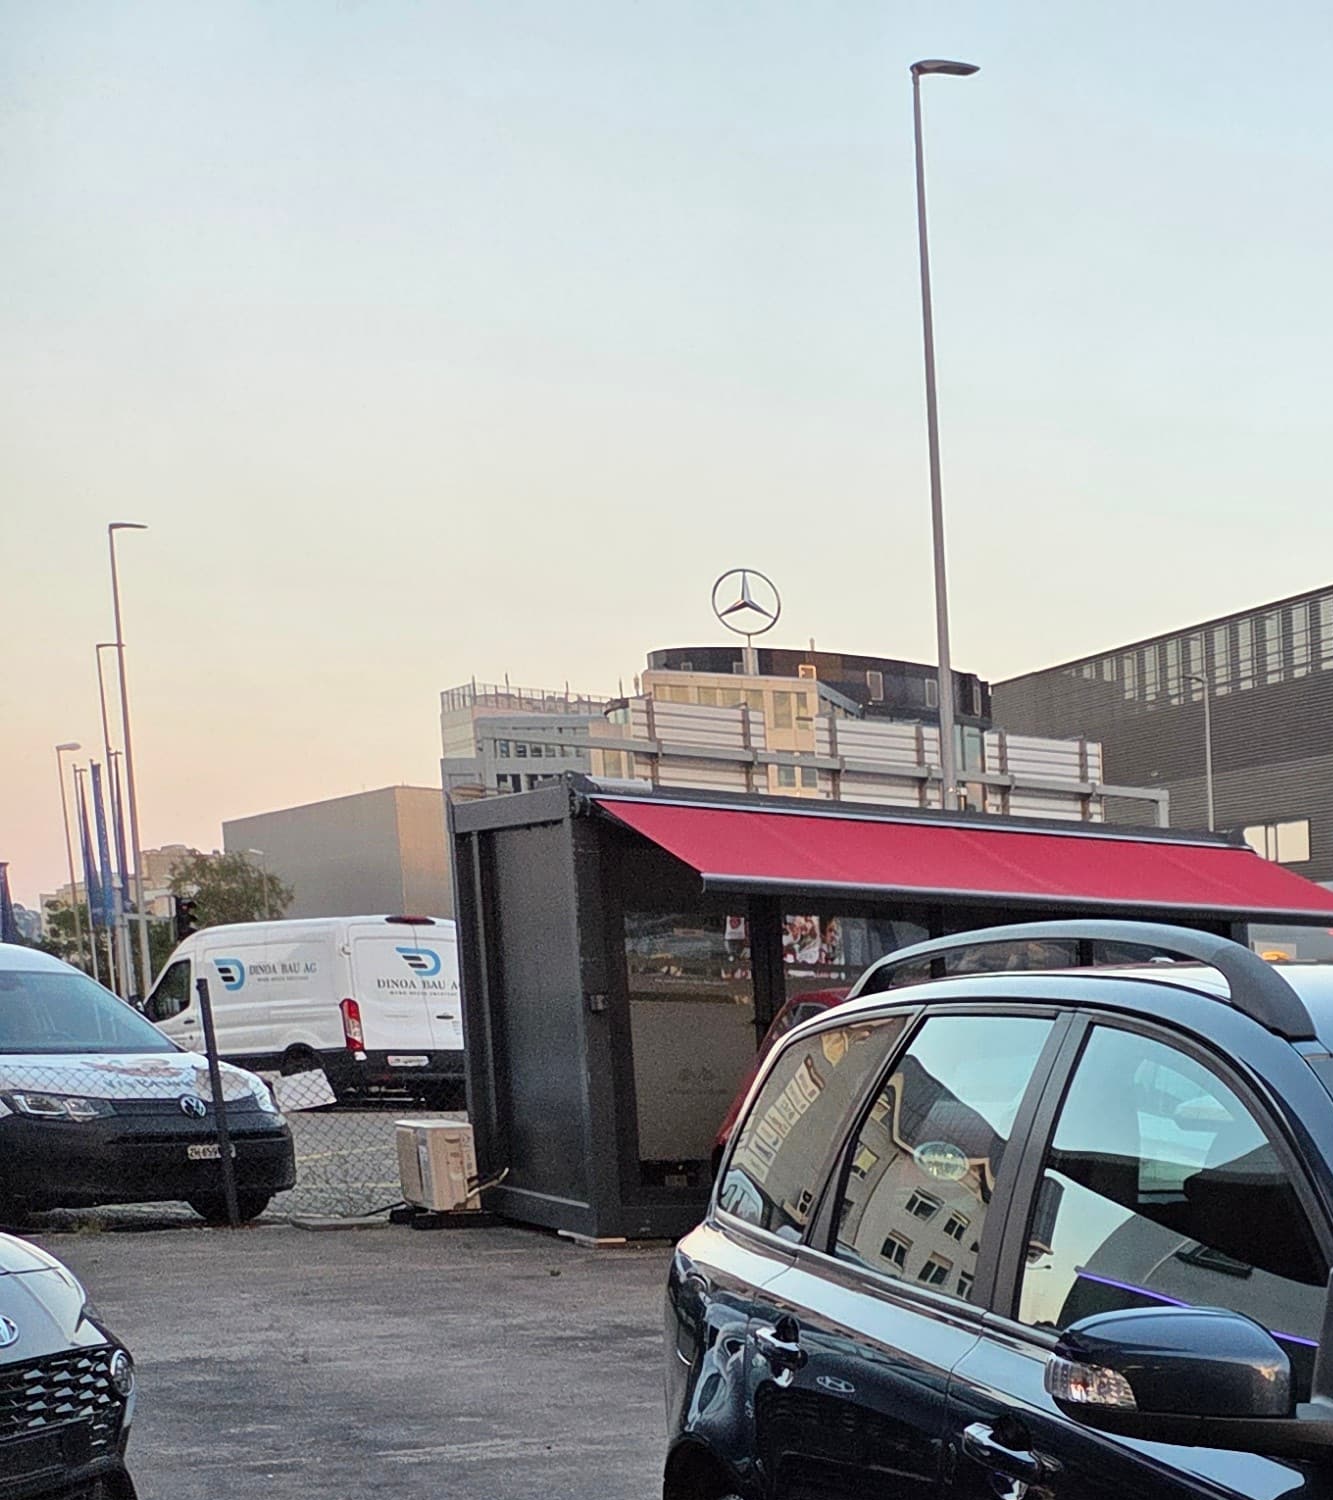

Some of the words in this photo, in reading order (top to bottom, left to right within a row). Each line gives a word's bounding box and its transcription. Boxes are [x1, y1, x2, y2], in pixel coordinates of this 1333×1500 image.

[281, 961, 300, 974] BAU
[303, 961, 317, 973] AG
[377, 978, 417, 989] DINOA
[422, 979, 446, 990] BAU
